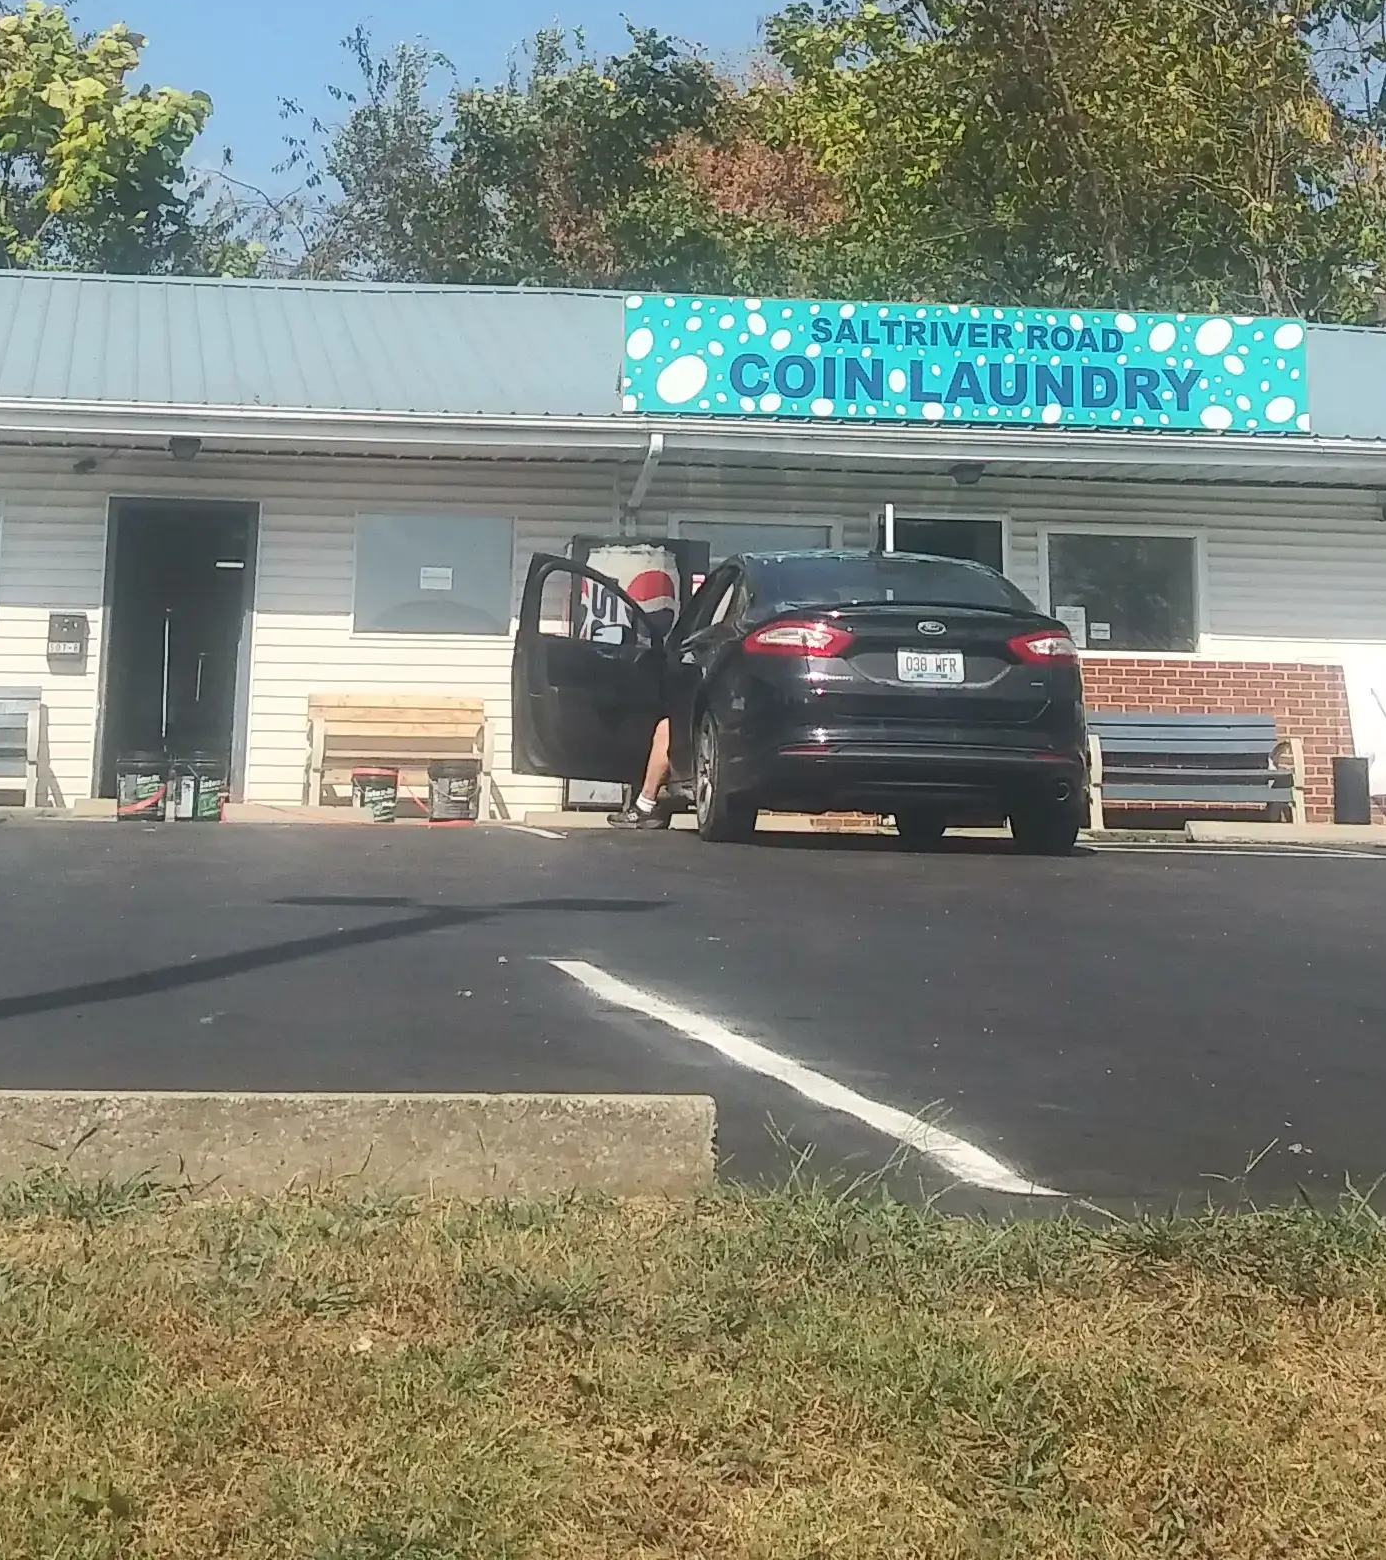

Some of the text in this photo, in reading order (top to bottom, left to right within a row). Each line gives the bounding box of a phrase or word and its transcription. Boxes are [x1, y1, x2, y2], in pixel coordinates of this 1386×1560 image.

[1026, 324, 1124, 354] ROAD
[729, 353, 1204, 412] COIN LAUNDRY
[906, 656, 957, 673] 038 WFR
